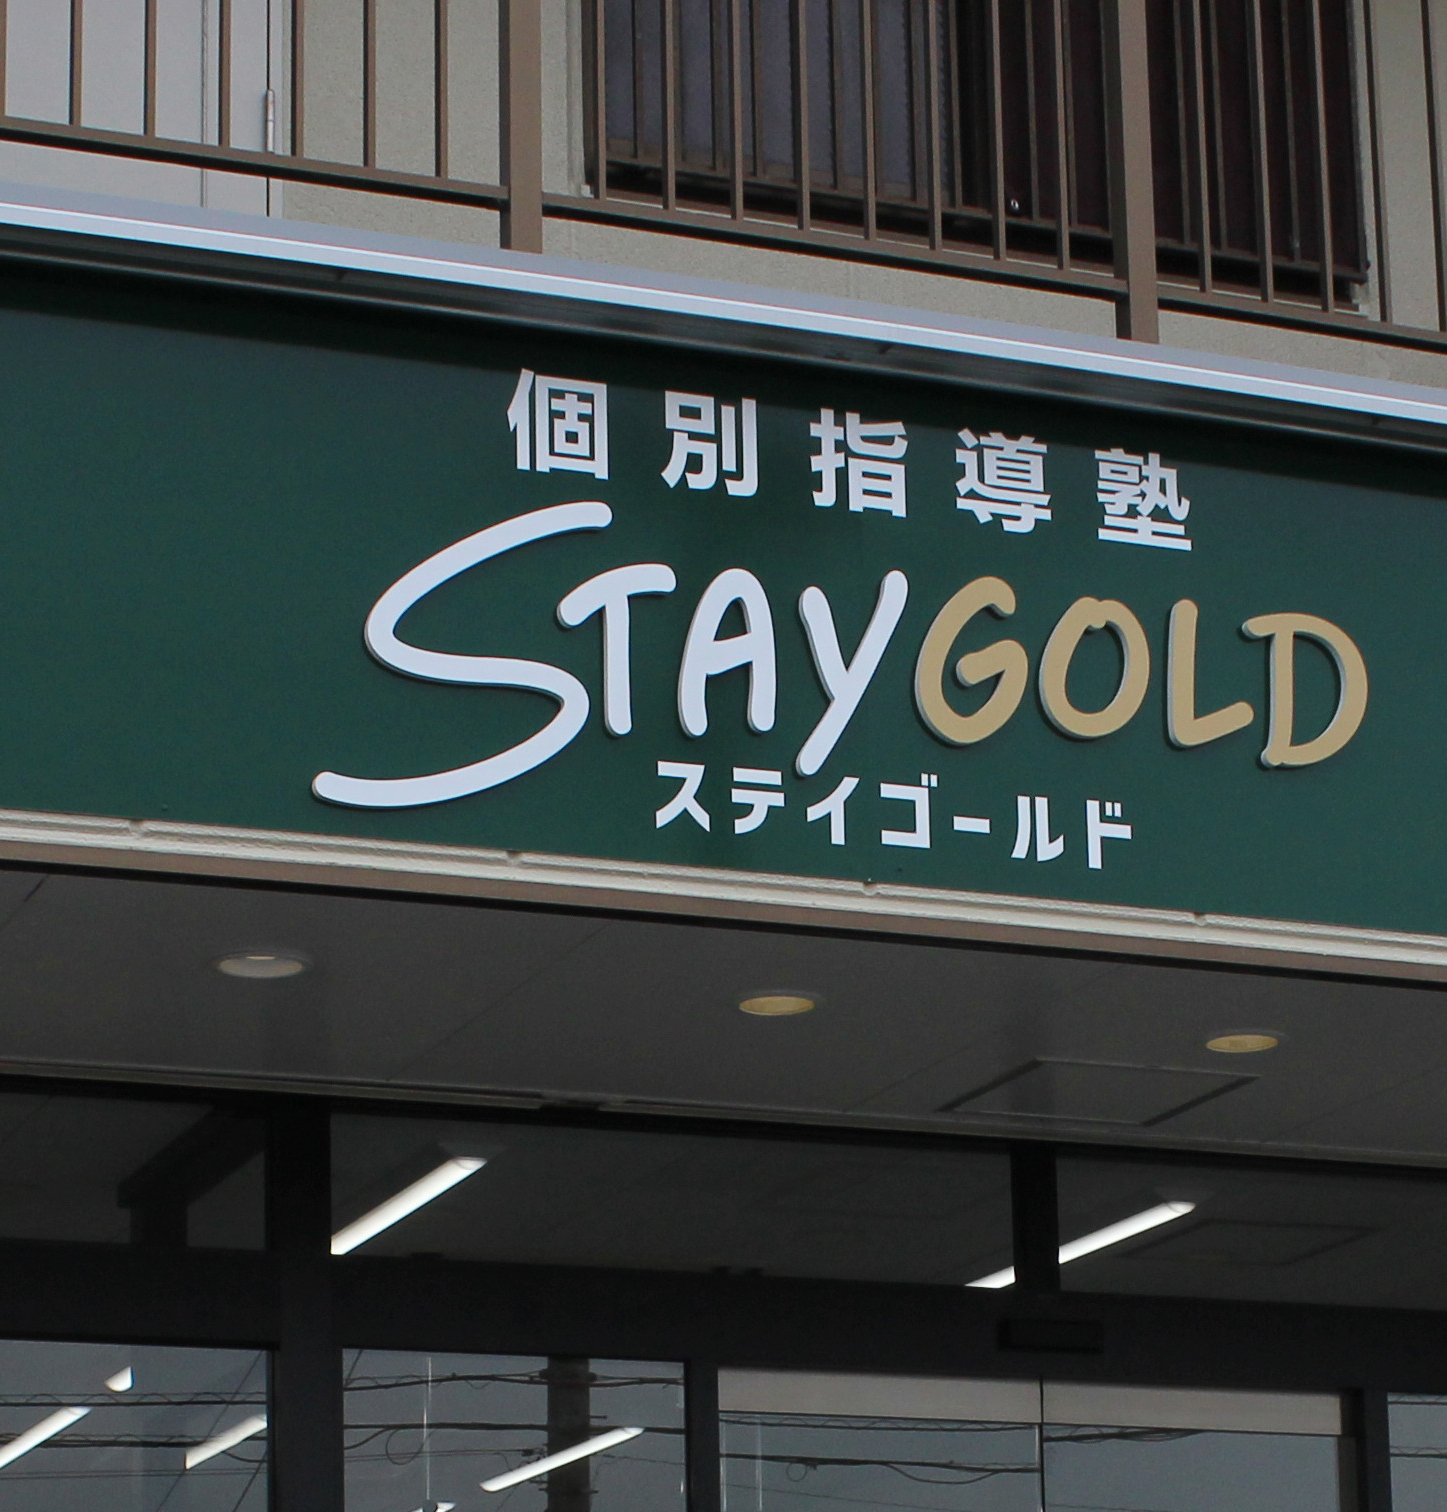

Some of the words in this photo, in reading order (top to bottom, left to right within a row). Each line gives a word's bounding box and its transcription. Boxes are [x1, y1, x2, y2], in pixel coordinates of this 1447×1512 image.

[508, 368, 1193, 551] 個別指導塾
[655, 760, 1134, 870] ステイゴールド
